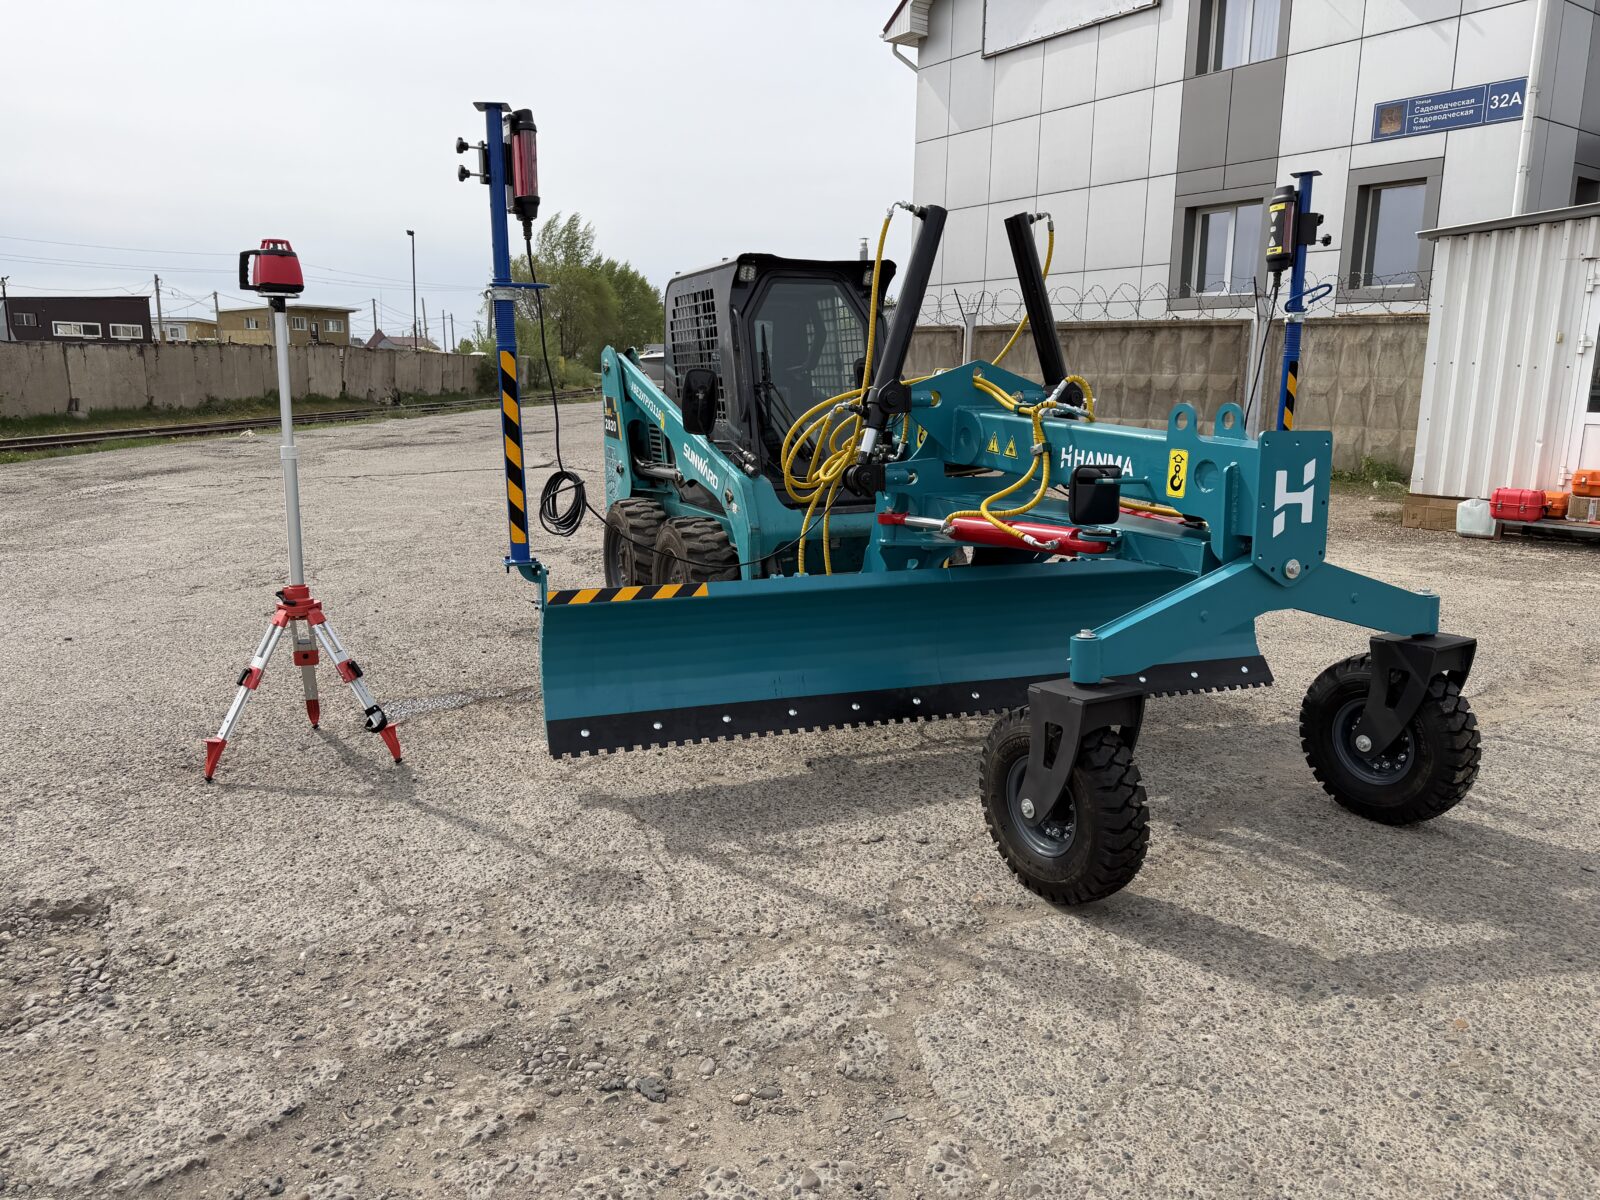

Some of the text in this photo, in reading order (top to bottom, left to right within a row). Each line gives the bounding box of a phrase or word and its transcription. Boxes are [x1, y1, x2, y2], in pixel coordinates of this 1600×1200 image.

[1414, 98, 1475, 114] Садоводческая
[1489, 91, 1522, 109] 32А
[1413, 109, 1474, 124] Садоводческая
[683, 442, 719, 490] SUNWARD
[1073, 448, 1134, 477] HANMA
